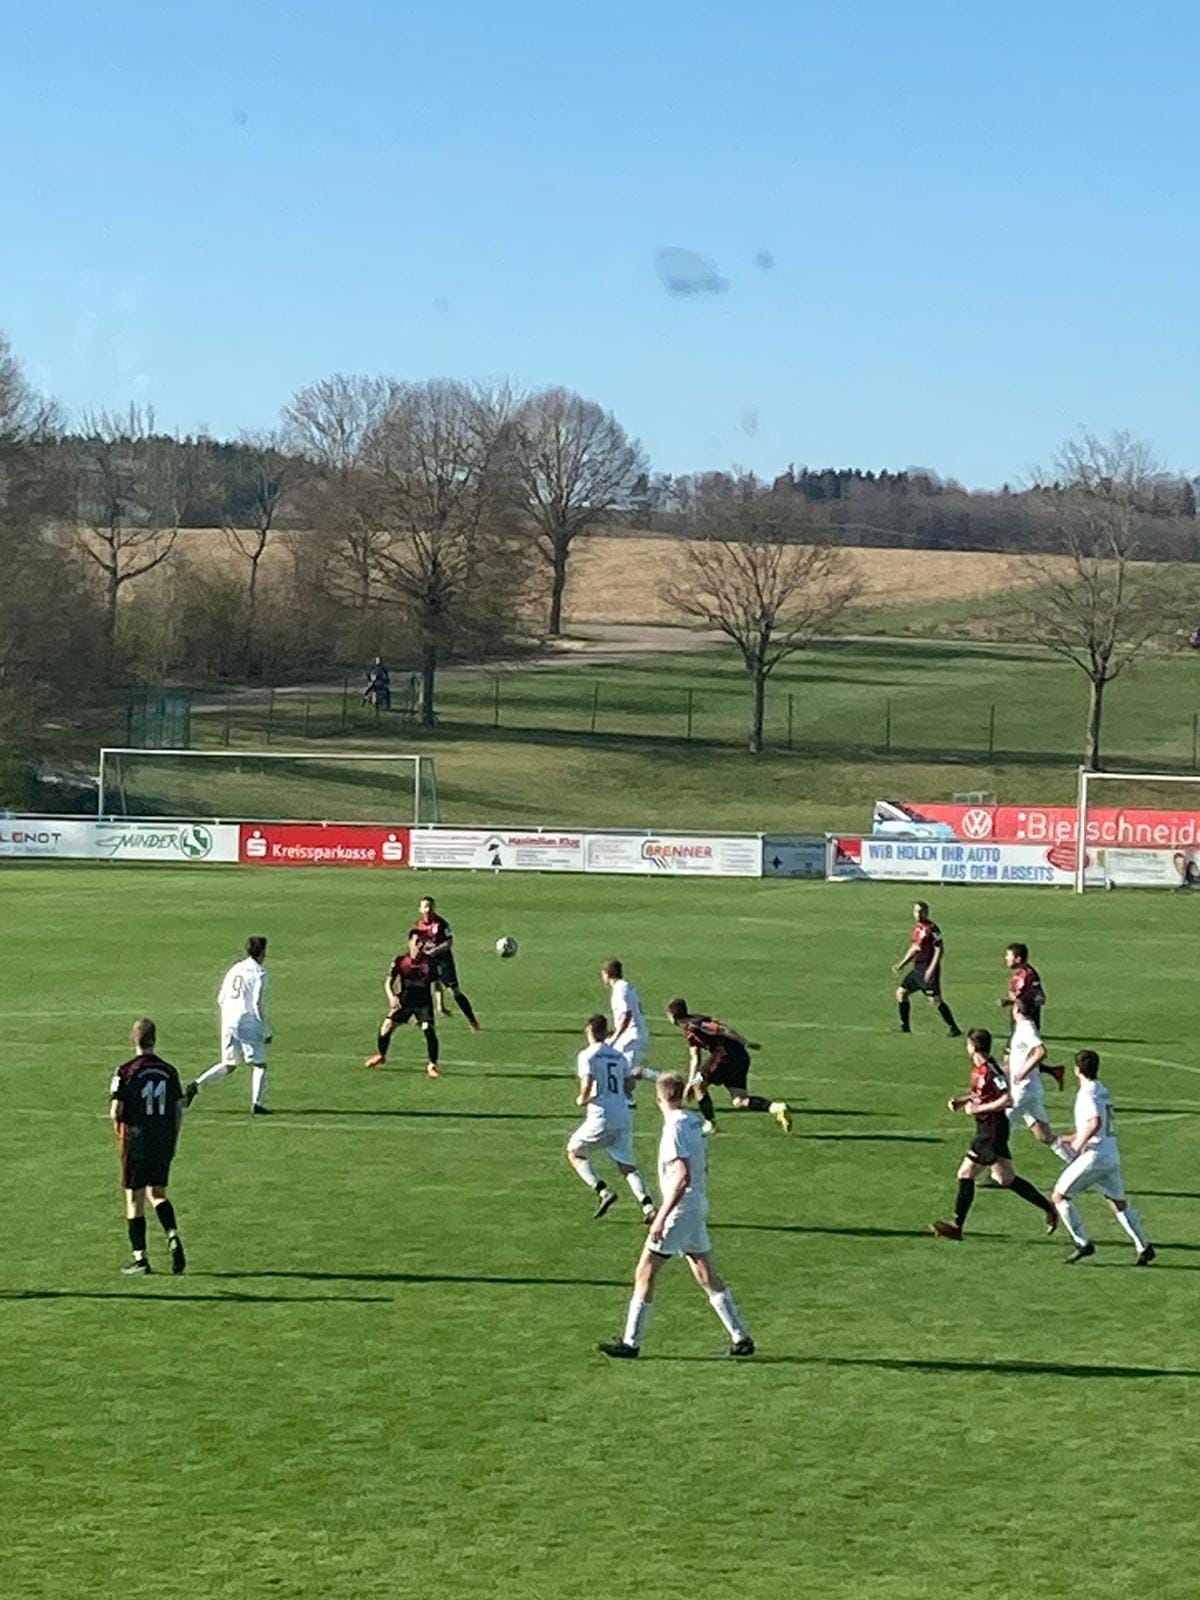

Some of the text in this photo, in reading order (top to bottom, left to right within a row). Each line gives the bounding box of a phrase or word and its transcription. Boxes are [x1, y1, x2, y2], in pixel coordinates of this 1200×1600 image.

[272, 844, 376, 861] Kreissparkasse
[645, 844, 712, 858] BRENNER
[869, 844, 1000, 863] WIR HOLEN IHR AUTO
[941, 864, 1054, 882] AUS DEM ABSEITS
[231, 975, 243, 999] 9
[140, 1080, 166, 1115] 11
